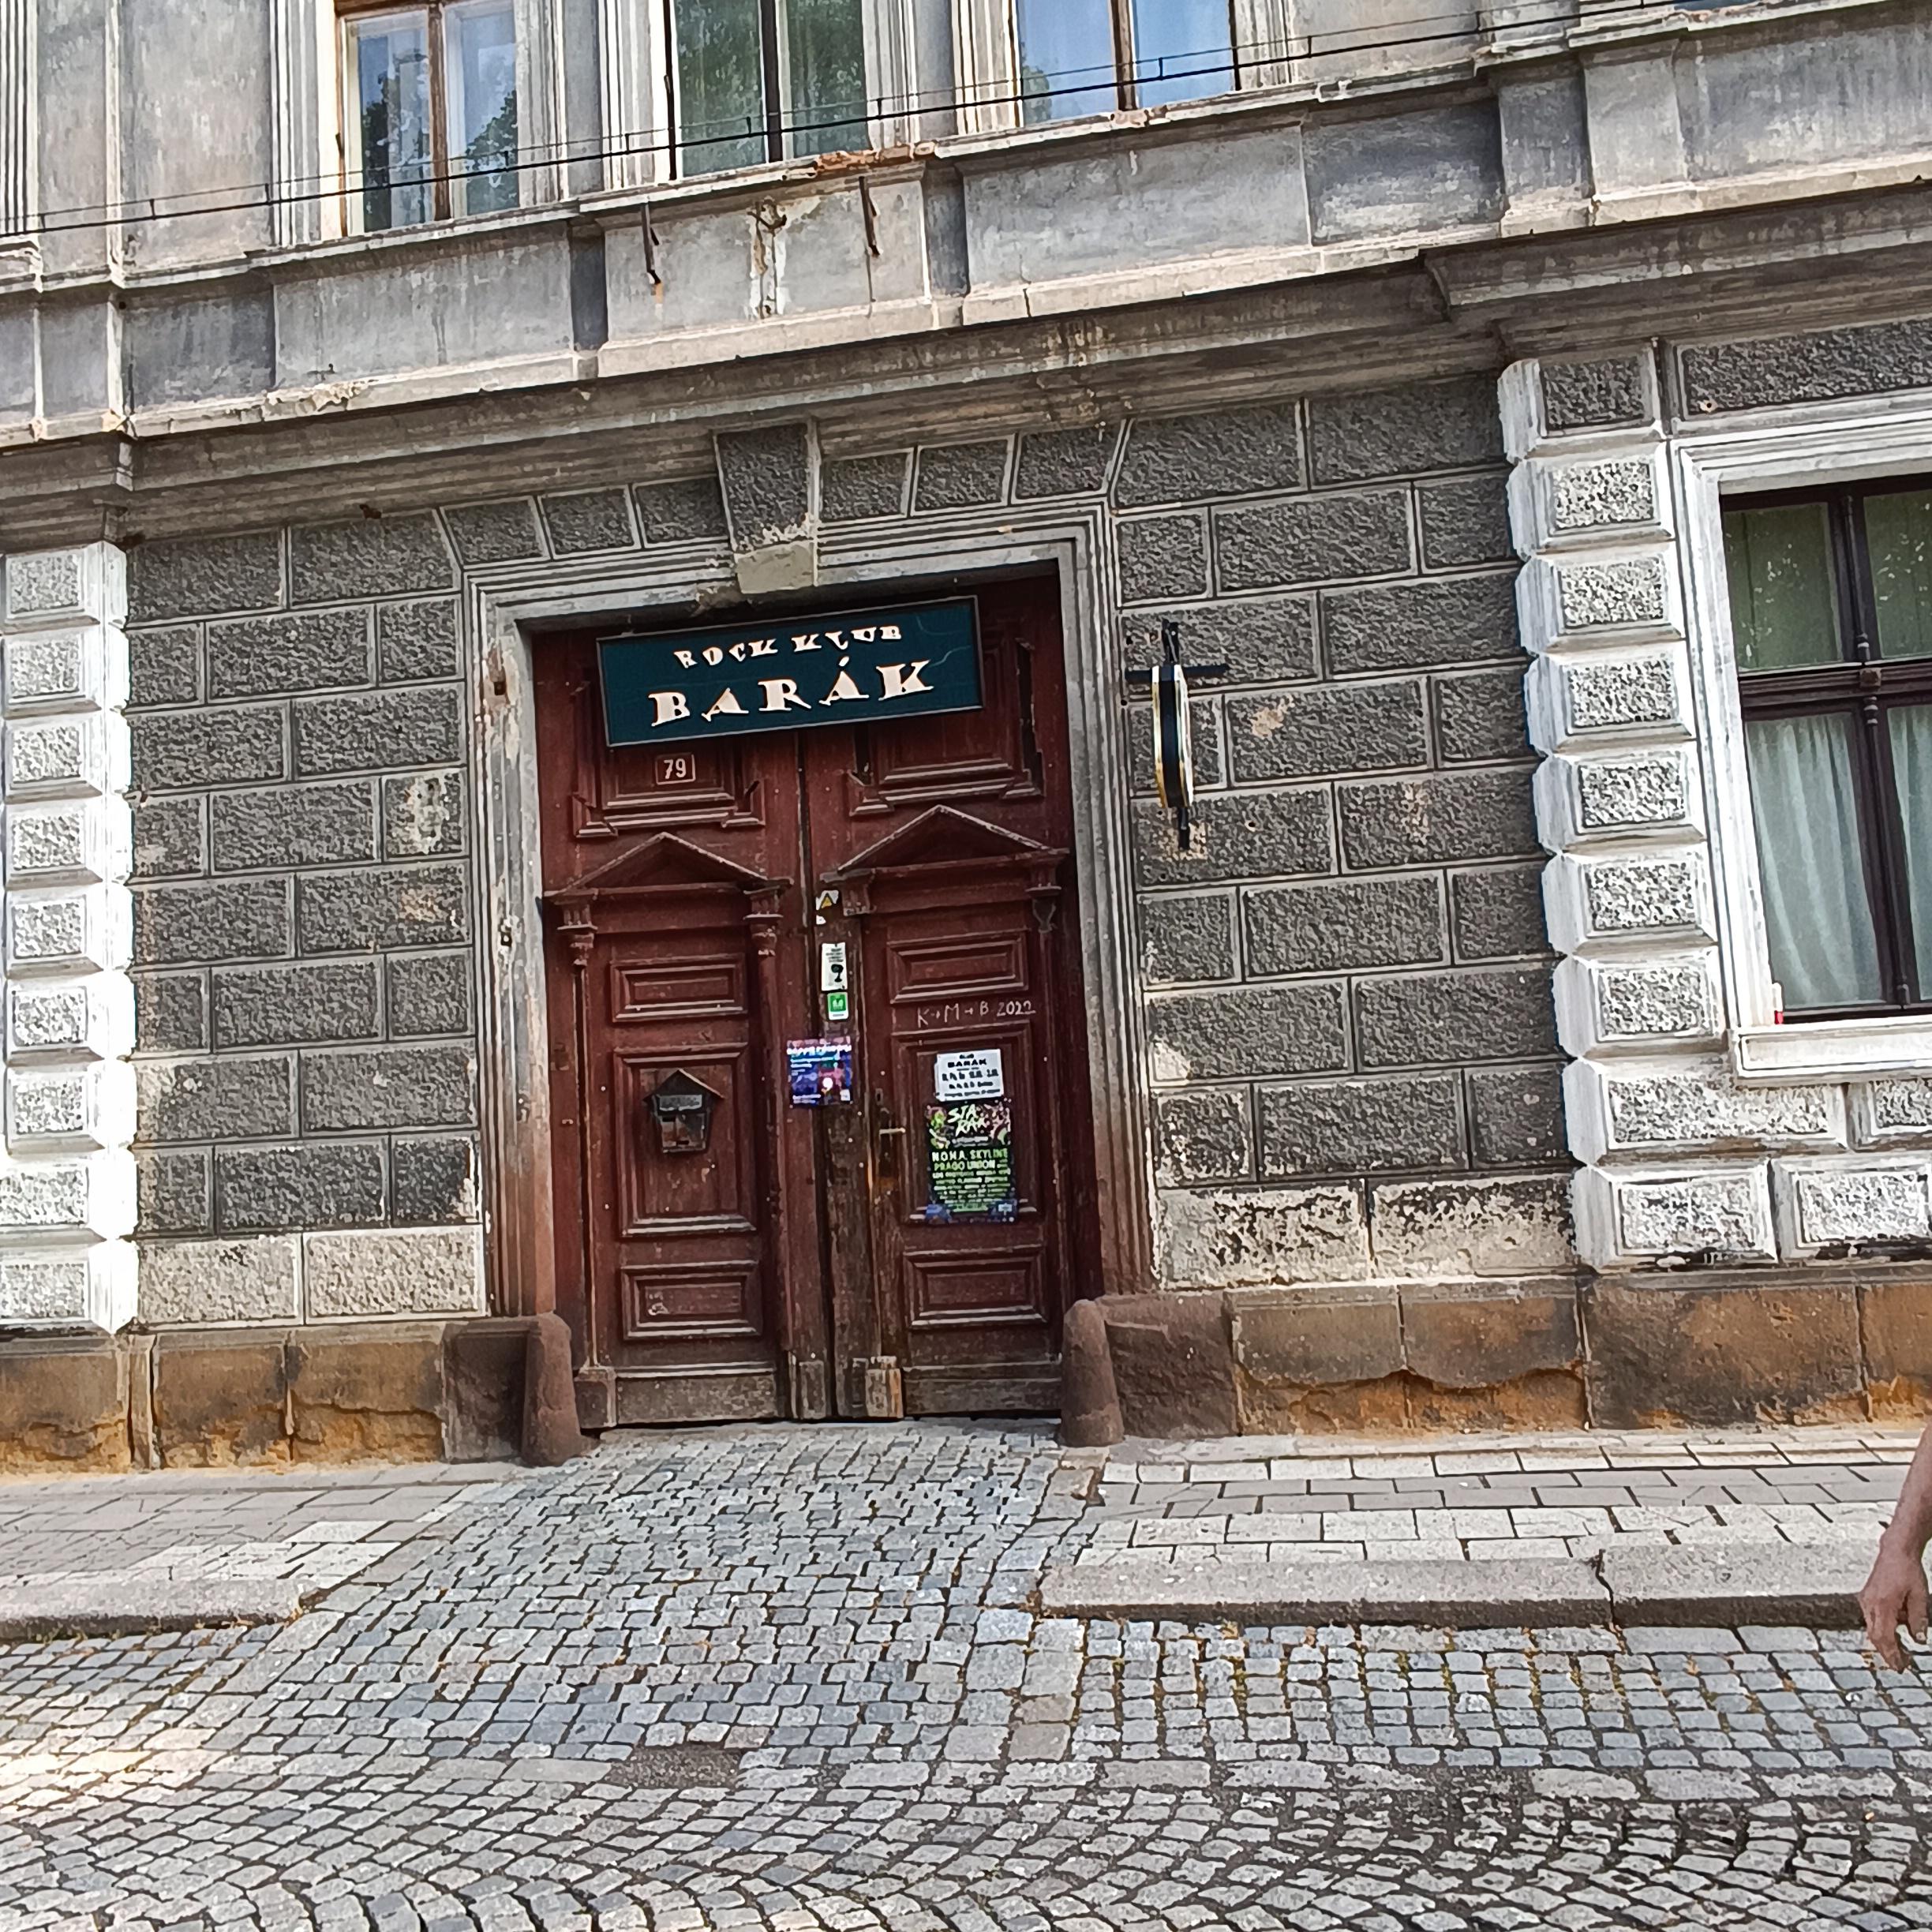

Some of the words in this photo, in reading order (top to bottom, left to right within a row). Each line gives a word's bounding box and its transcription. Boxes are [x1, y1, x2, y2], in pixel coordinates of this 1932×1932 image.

[674, 638, 778, 668] ROCK
[792, 625, 902, 653] KLUB
[648, 656, 934, 727] BARÁK
[663, 758, 687, 780] 79
[997, 1000, 1036, 1017] 2022
